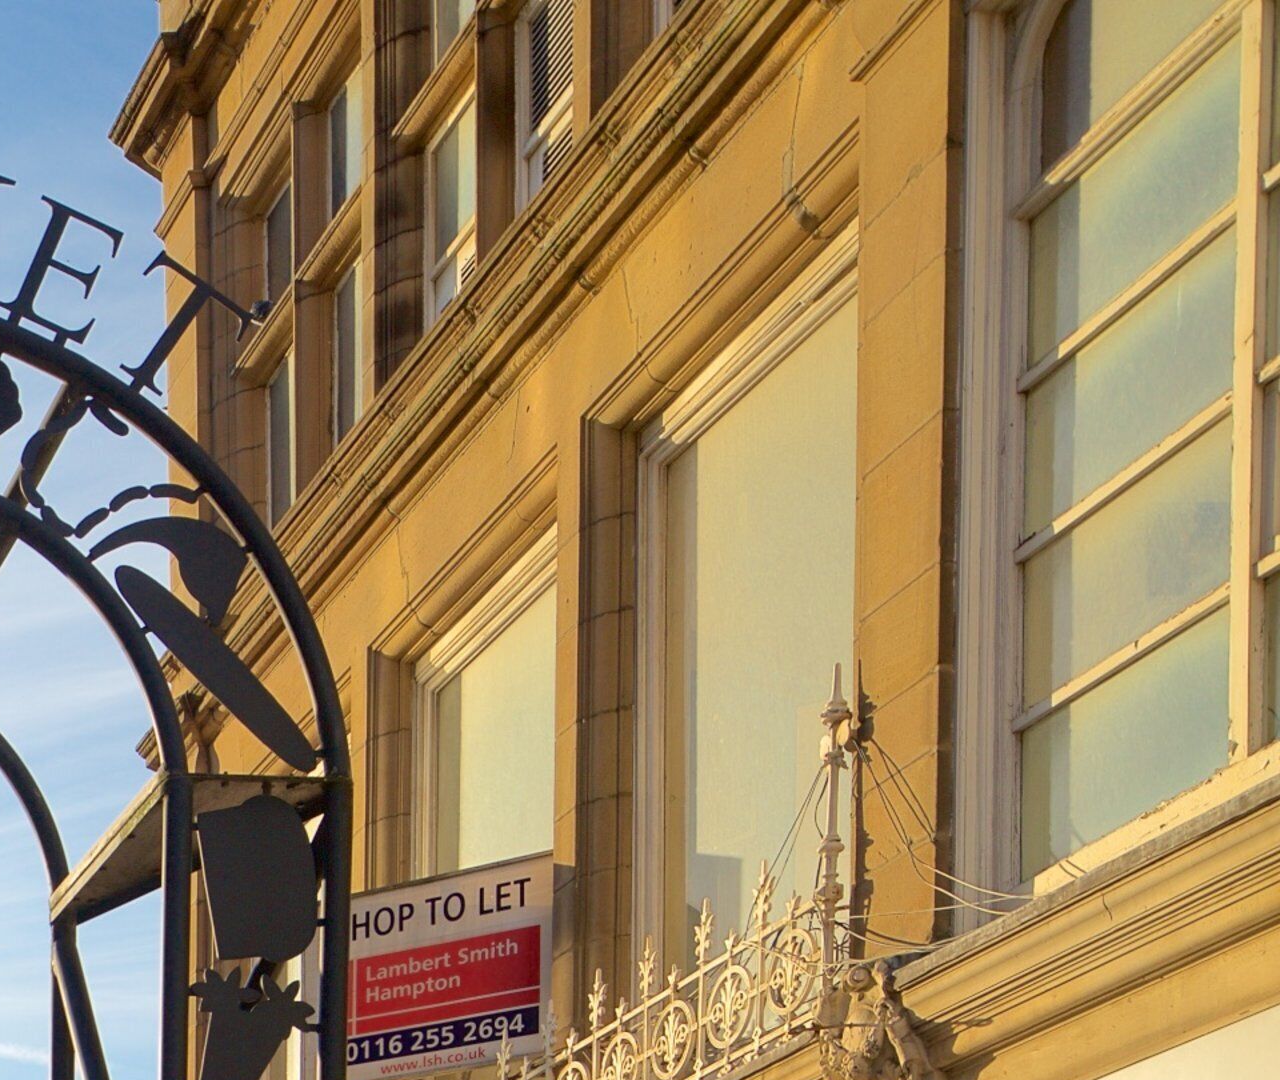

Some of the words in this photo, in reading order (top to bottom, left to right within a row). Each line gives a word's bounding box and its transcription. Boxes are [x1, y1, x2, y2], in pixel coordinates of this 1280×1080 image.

[351, 902, 415, 941] HOP
[424, 892, 466, 926] TO
[479, 877, 532, 917] LET
[365, 952, 452, 983] Lambert
[457, 937, 520, 966] Smith
[365, 974, 462, 1005] Hampton
[347, 1035, 403, 1063] 0116
[410, 1025, 455, 1052] 255
[463, 1012, 525, 1043] 2694
[380, 1046, 486, 1075] www.lsh.co.uk
